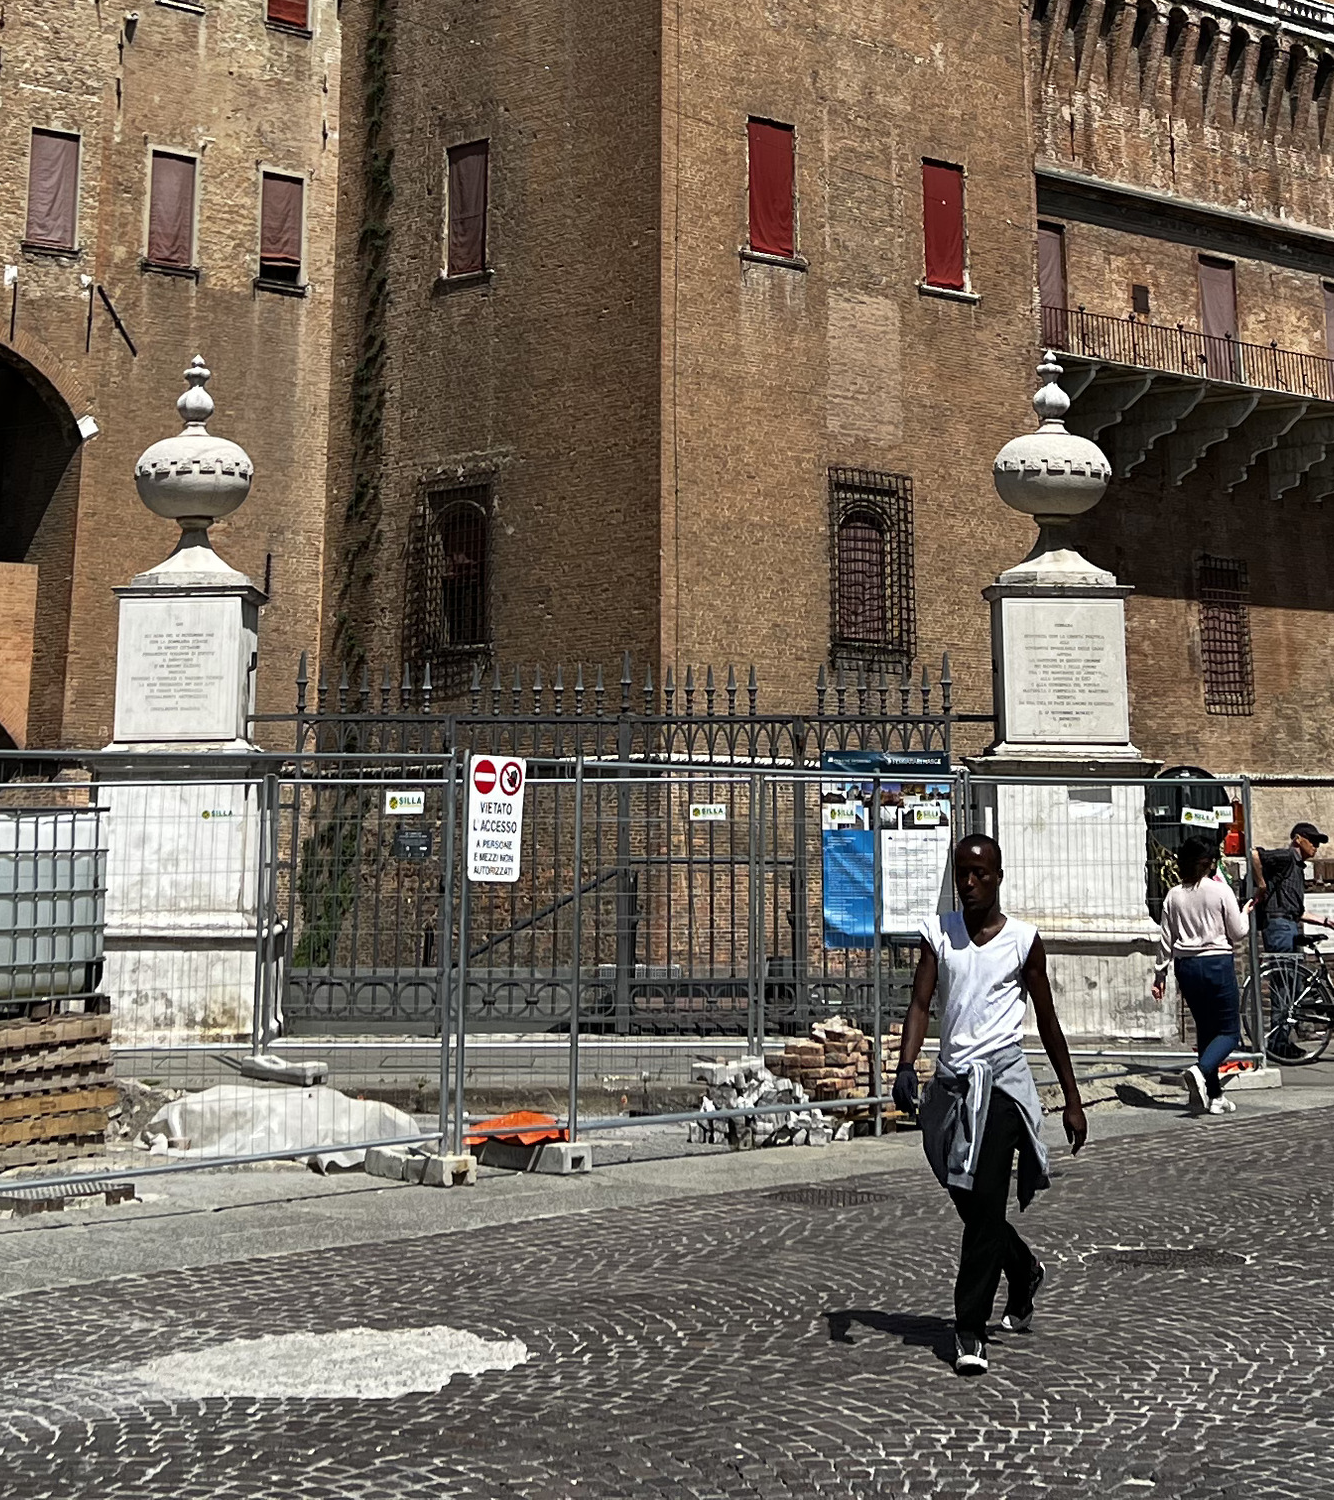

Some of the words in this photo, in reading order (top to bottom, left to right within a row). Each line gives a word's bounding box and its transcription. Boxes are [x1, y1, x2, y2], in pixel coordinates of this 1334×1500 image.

[399, 796, 422, 805] SILLA
[480, 802, 512, 815] VIETATO
[476, 840, 481, 848] A
[482, 840, 513, 850] PERSONE
[474, 853, 478, 862] E
[479, 853, 498, 862] MEZZI
